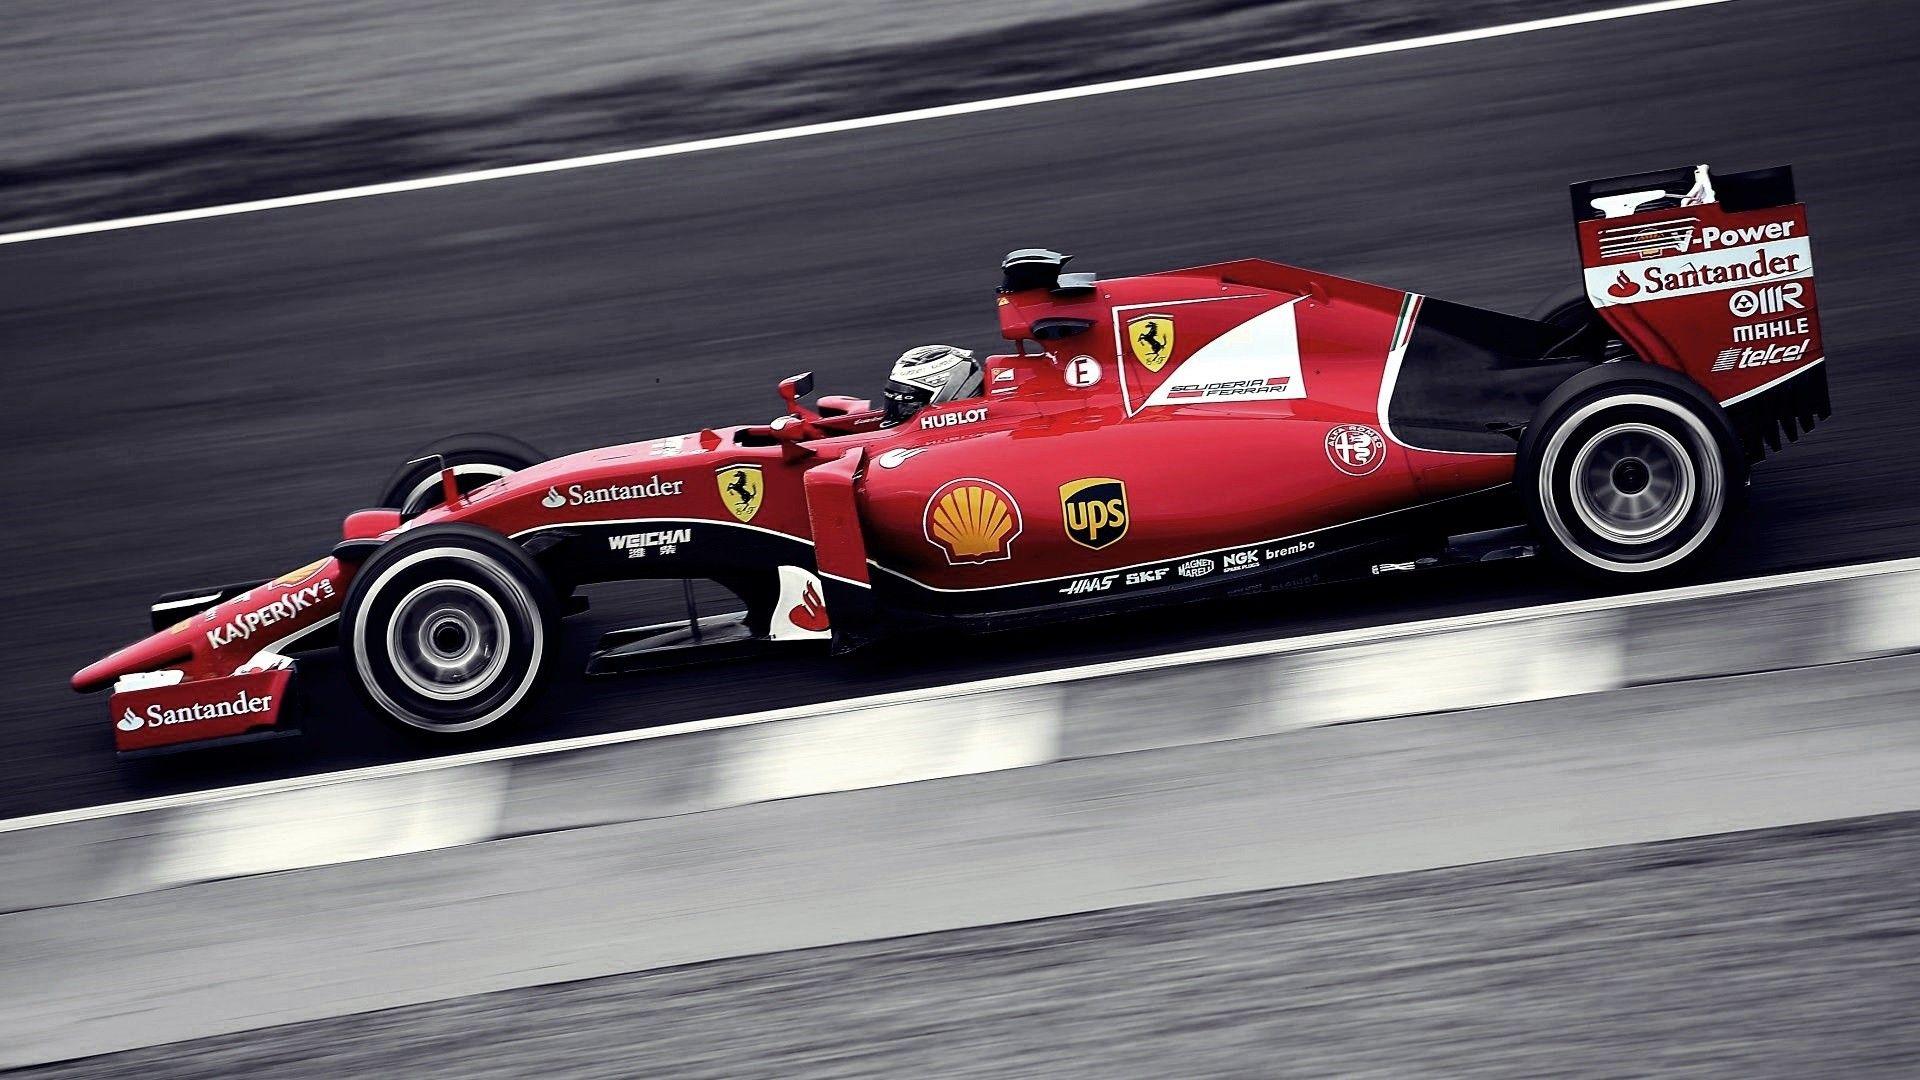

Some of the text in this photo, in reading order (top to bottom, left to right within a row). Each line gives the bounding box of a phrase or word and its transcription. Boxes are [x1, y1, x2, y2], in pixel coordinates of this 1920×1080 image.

[1645, 249, 1799, 293] Santander
[1733, 318, 1809, 342] MAHLE
[1739, 339, 1810, 368] telcel
[1074, 359, 1090, 385] E
[1170, 379, 1264, 391] SCUDERIA
[1206, 386, 1288, 396] FERRARI
[920, 408, 988, 429] HUBLOT
[569, 475, 683, 506] Santander
[1067, 498, 1125, 540] ups
[608, 528, 692, 550] WEICHAI
[1265, 541, 1315, 560] brembo
[1223, 549, 1259, 568] NGK
[1059, 574, 1120, 595] HAAS
[1126, 567, 1170, 586] SKF
[206, 583, 321, 649] KASPERSKY
[147, 690, 273, 728] Santander
